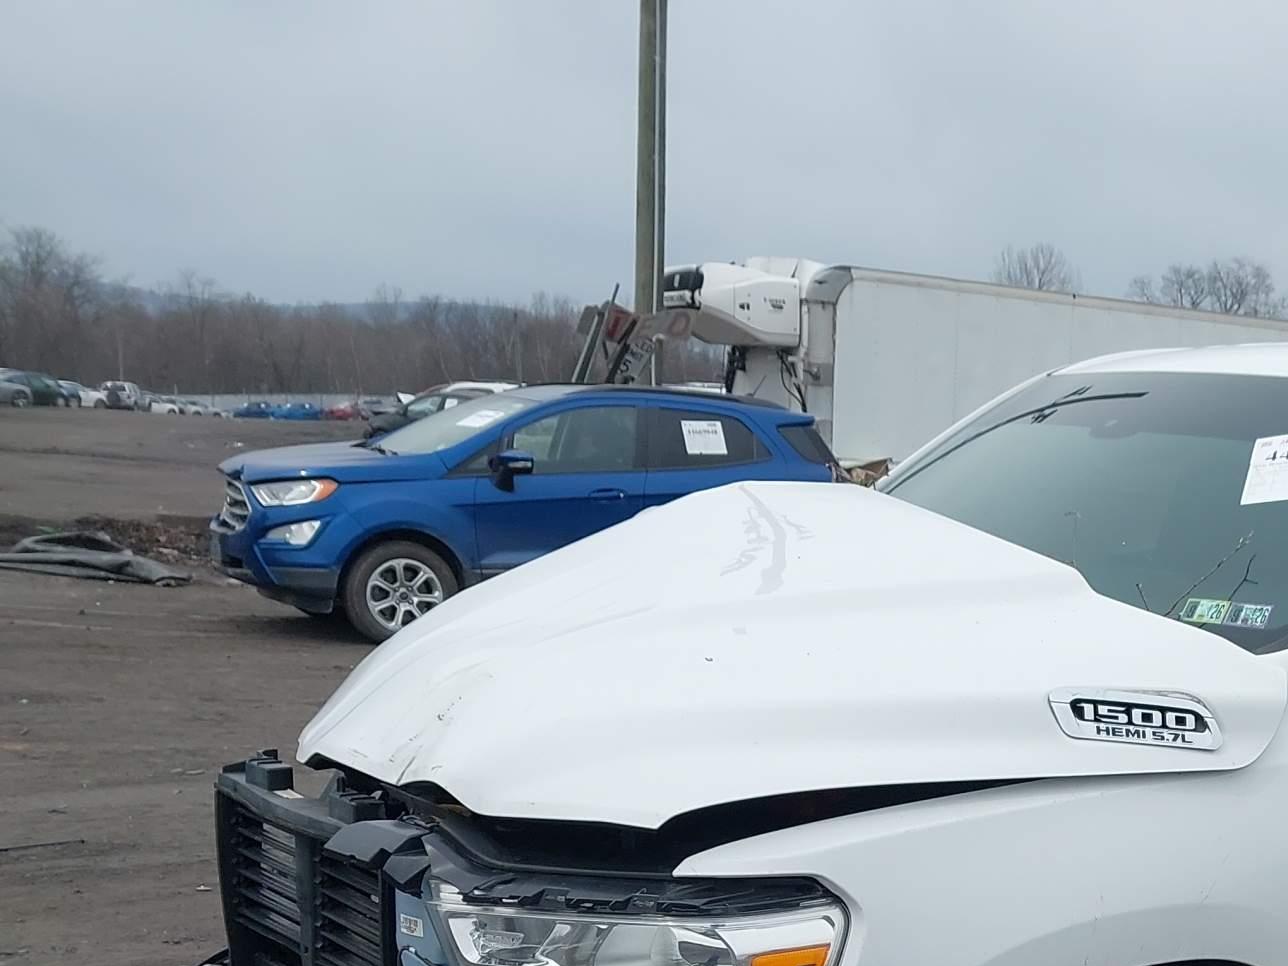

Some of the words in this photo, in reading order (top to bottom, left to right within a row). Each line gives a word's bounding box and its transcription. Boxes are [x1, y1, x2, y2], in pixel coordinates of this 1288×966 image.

[1075, 702, 1196, 730] 1500
[1096, 725, 1147, 740] HEMI
[1151, 730, 1193, 744] 5.7L
